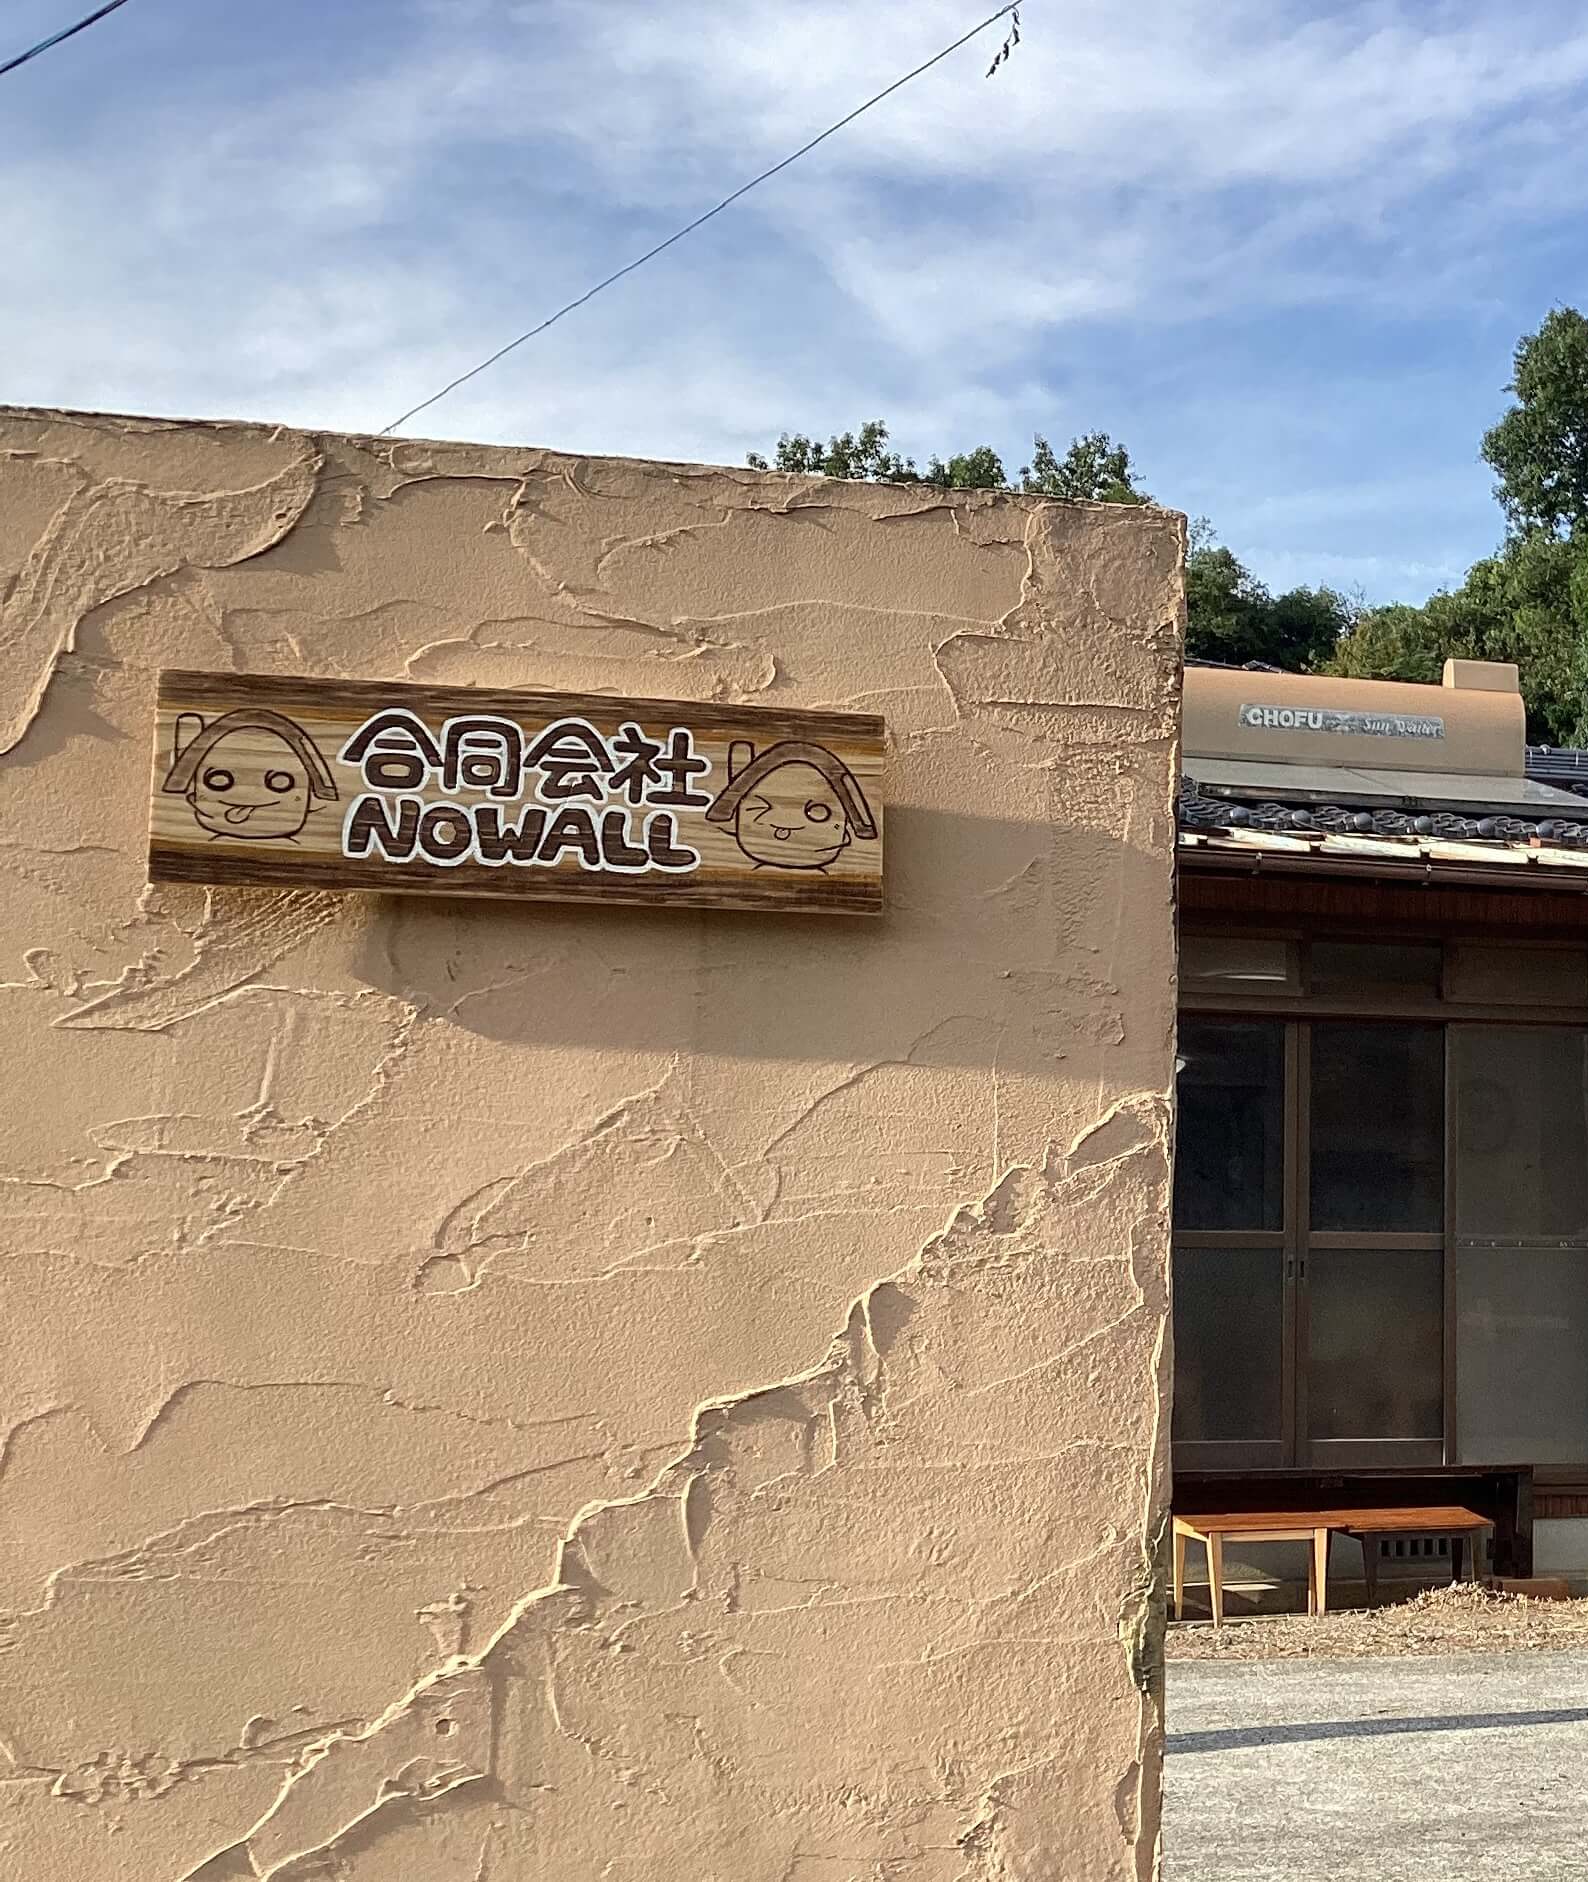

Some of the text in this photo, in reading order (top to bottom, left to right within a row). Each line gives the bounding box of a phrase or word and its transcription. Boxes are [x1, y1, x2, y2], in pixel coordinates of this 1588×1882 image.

[337, 707, 712, 808] 合同会社
[1247, 707, 1323, 729] CHOFU
[342, 795, 702, 874] NOWALL
